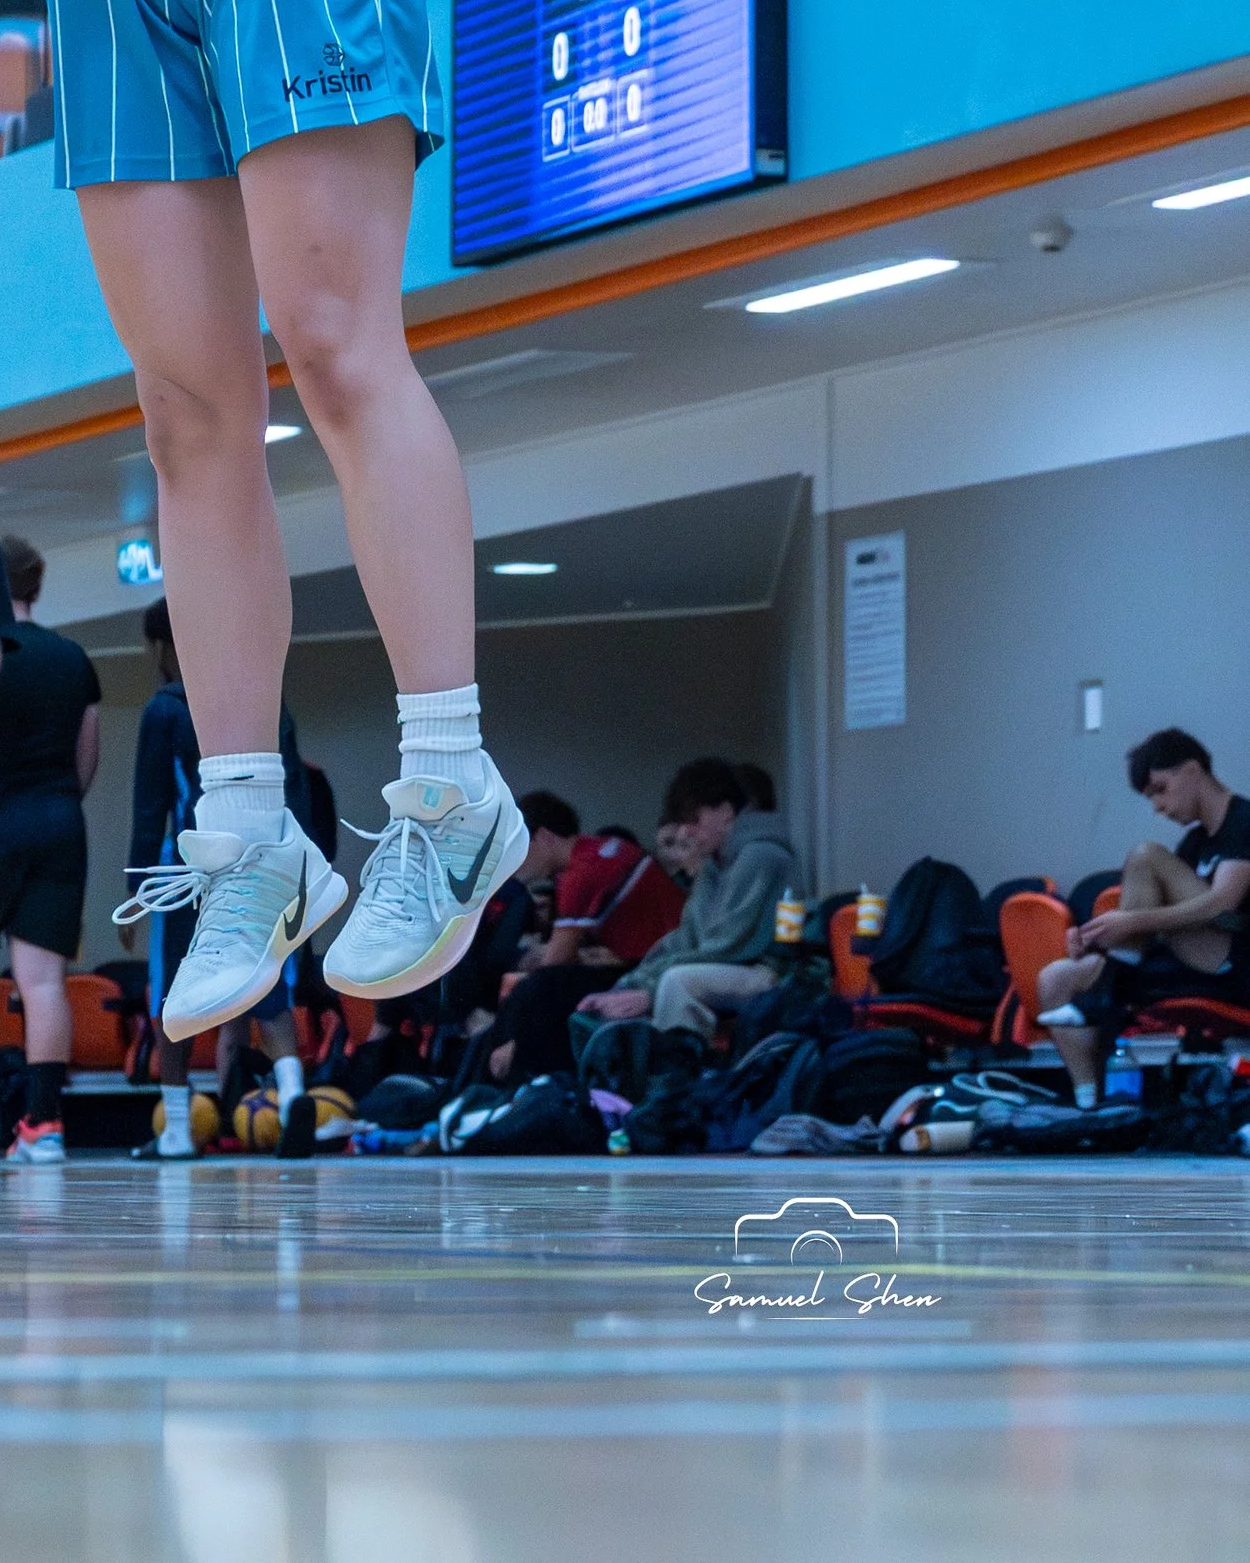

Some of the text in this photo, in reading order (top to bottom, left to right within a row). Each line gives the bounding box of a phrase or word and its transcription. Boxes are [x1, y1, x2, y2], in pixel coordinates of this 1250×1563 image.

[623, 6, 641, 56] 0
[553, 32, 569, 80] 0
[281, 67, 373, 103] Kristin
